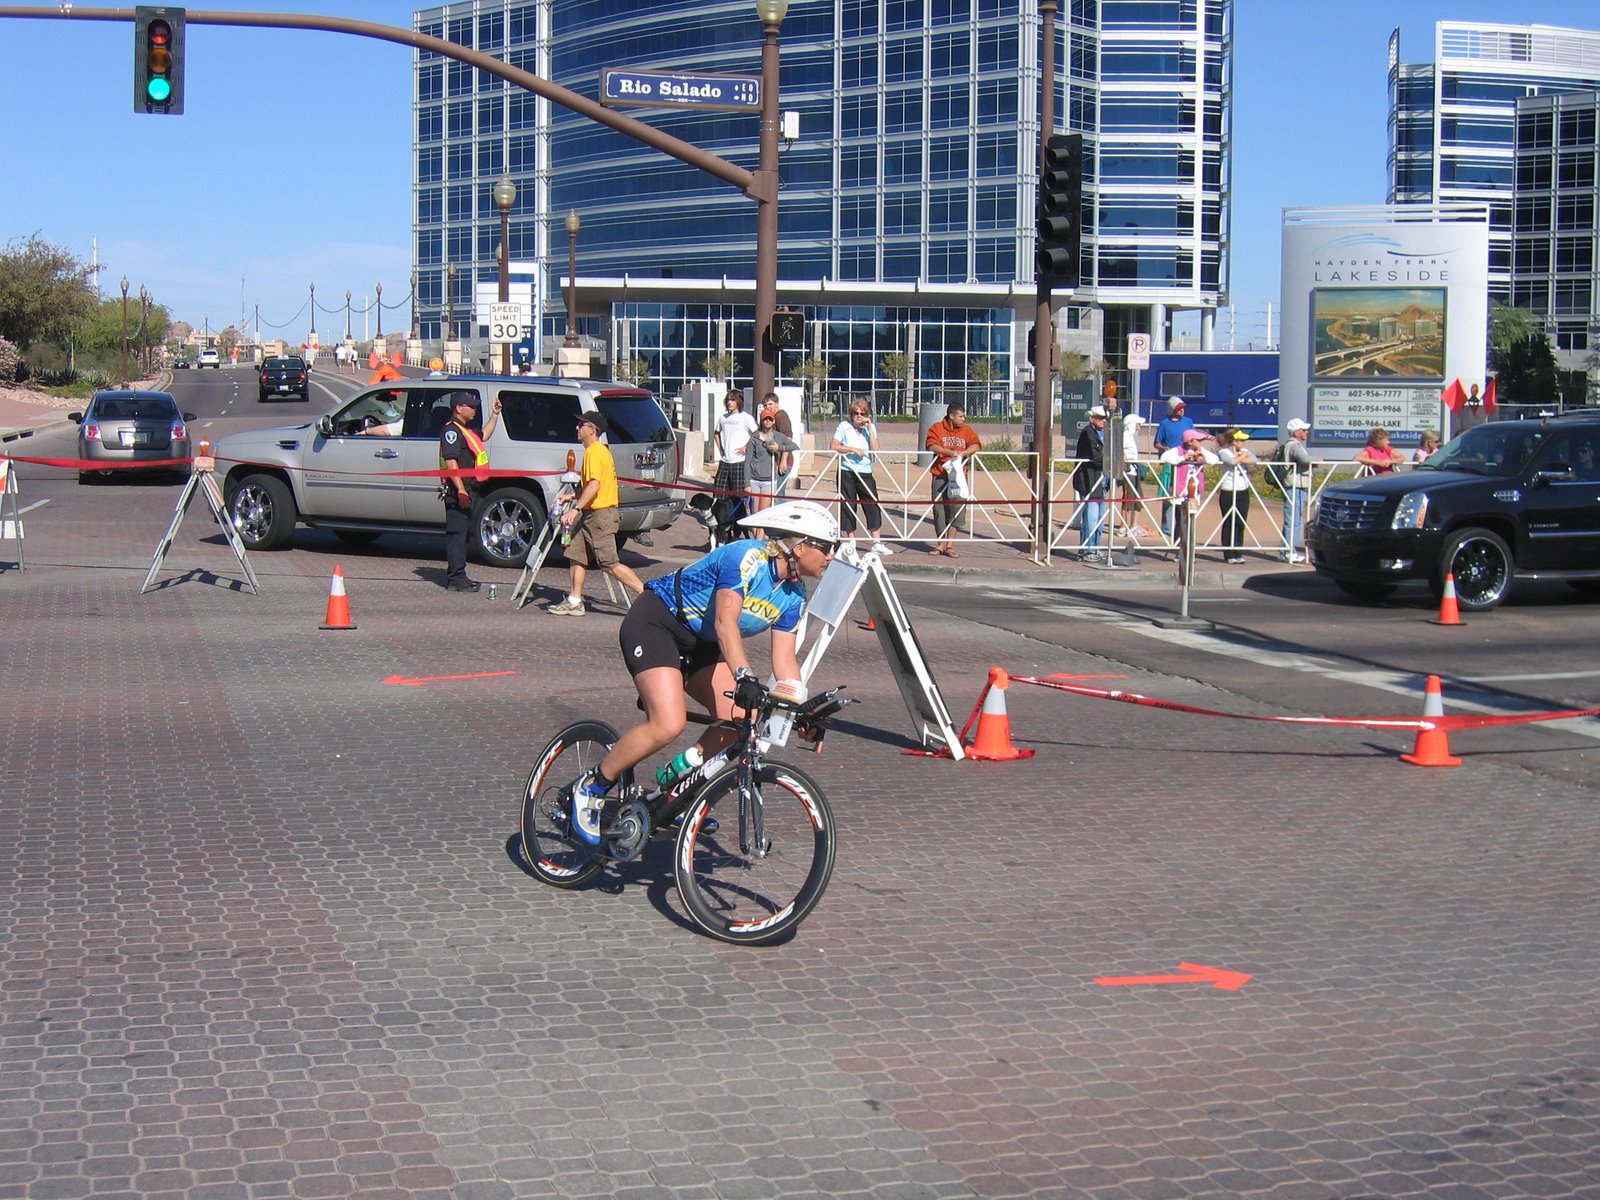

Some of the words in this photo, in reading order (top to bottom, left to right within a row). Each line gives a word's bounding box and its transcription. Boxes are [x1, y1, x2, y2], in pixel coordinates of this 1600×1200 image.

[620, 79, 651, 94] Rio
[659, 82, 721, 98] Salado
[1315, 271, 1448, 281] LAKESIDE
[494, 324, 518, 338] 30
